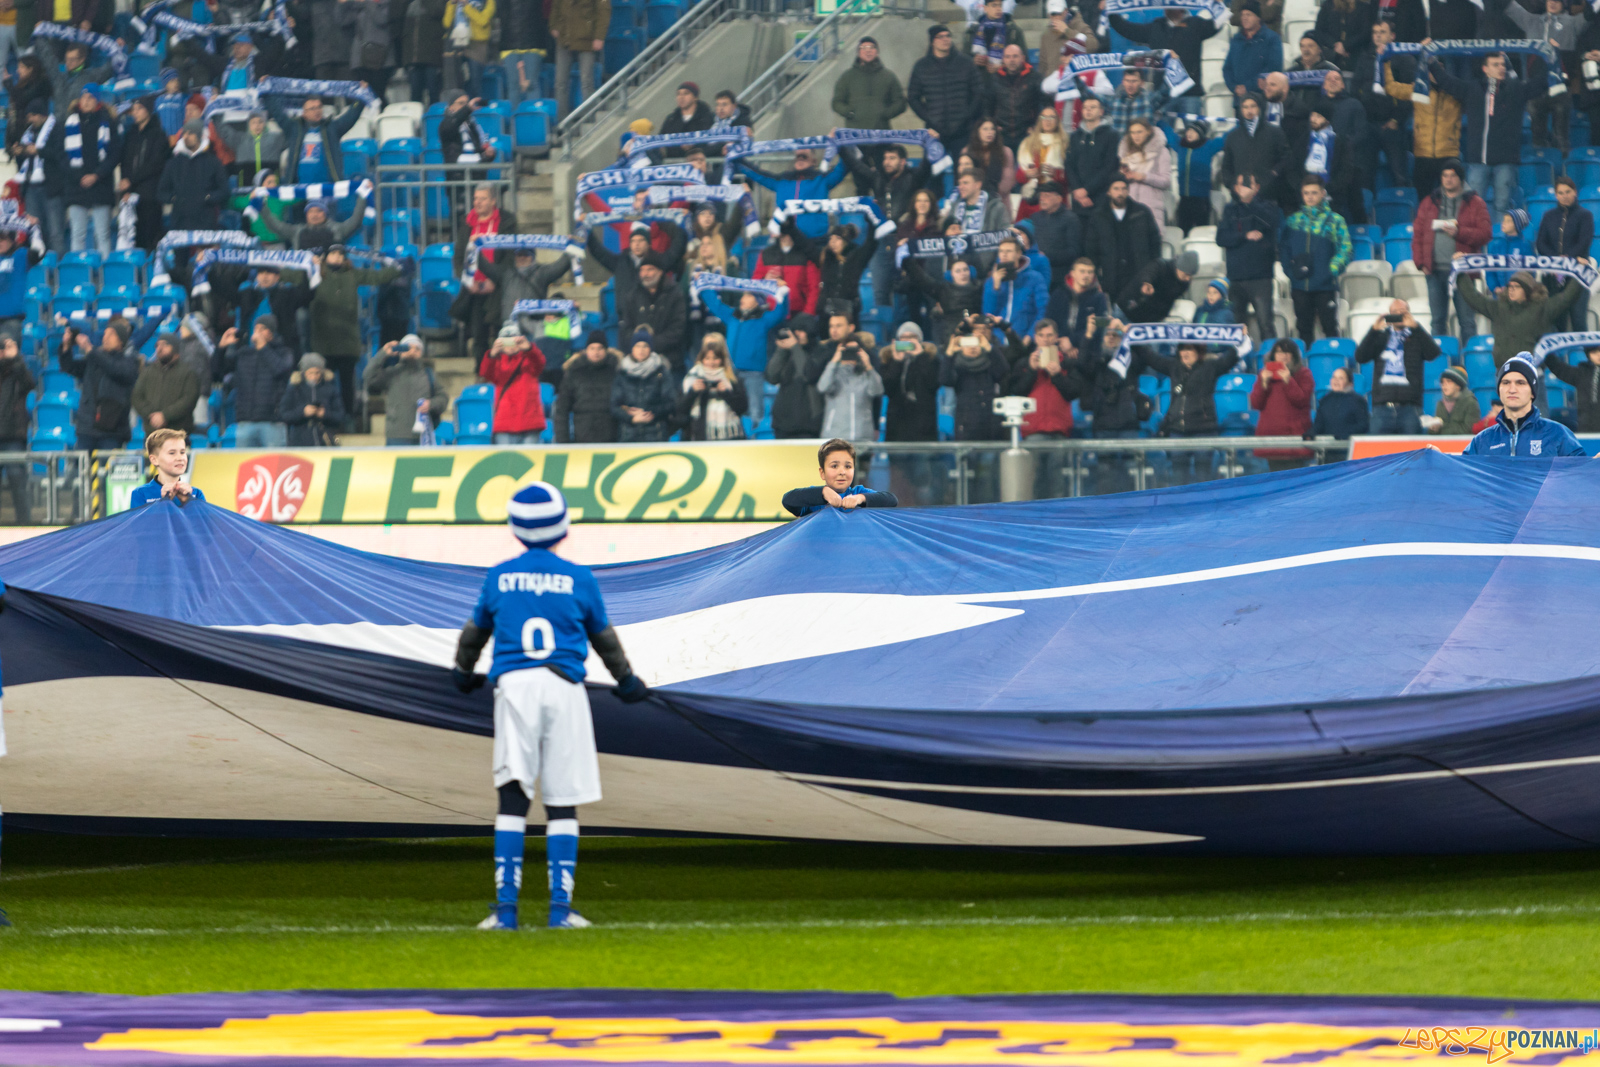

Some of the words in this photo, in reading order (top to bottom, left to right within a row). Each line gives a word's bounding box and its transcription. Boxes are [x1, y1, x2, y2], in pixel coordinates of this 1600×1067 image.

[577, 171, 624, 191] ECH
[784, 199, 839, 214] ECH
[917, 238, 945, 251] LECH
[1452, 254, 1506, 270] ECH
[1128, 325, 1167, 340] CH
[1182, 326, 1243, 341] POZNA
[319, 451, 616, 523] LECH
[498, 572, 574, 596] GYTKJAER
